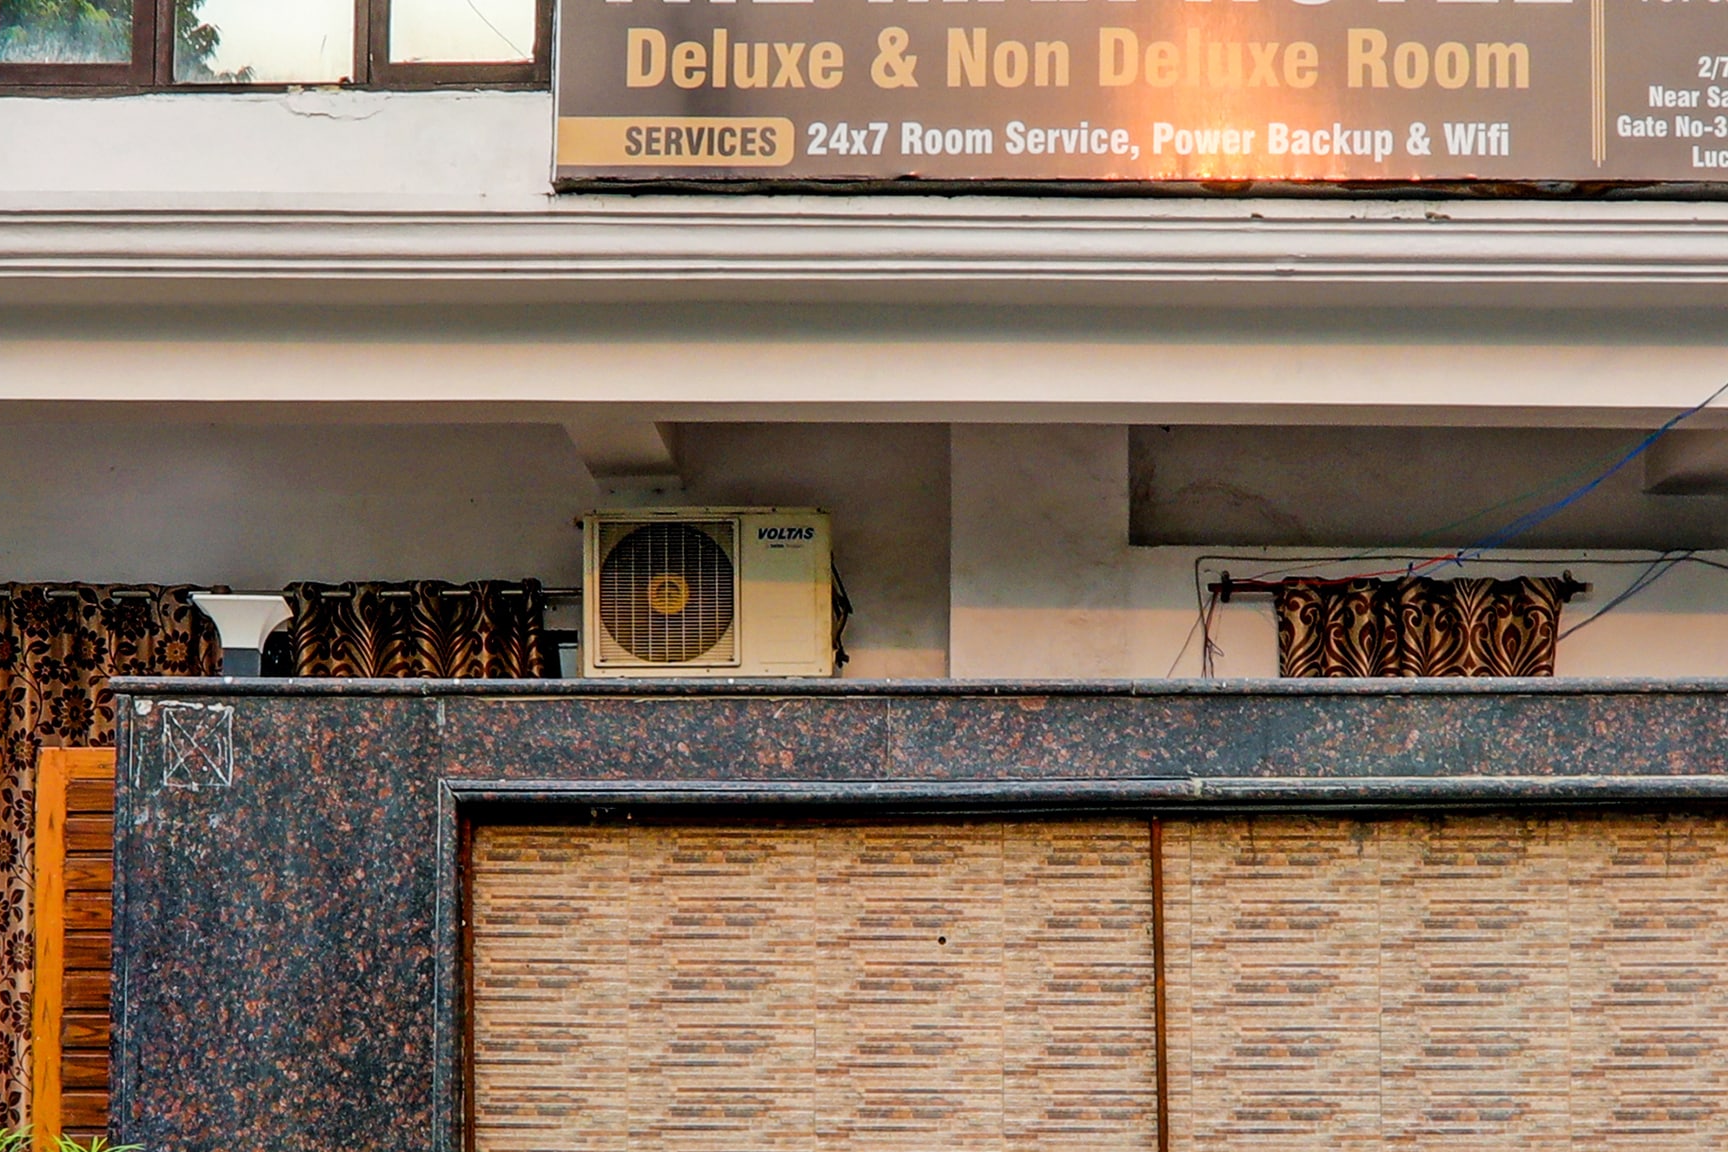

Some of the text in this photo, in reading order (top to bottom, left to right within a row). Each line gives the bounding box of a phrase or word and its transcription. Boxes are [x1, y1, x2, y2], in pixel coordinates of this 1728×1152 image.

[626, 26, 1531, 89] Deluxe & Non Deluxe Room
[1649, 85, 1700, 108] Near
[1617, 115, 1668, 137] Gate
[625, 120, 1510, 163] SERVICES 24x7 Room Service, Power Backup & Wifi
[758, 527, 815, 540] VOLTAS
